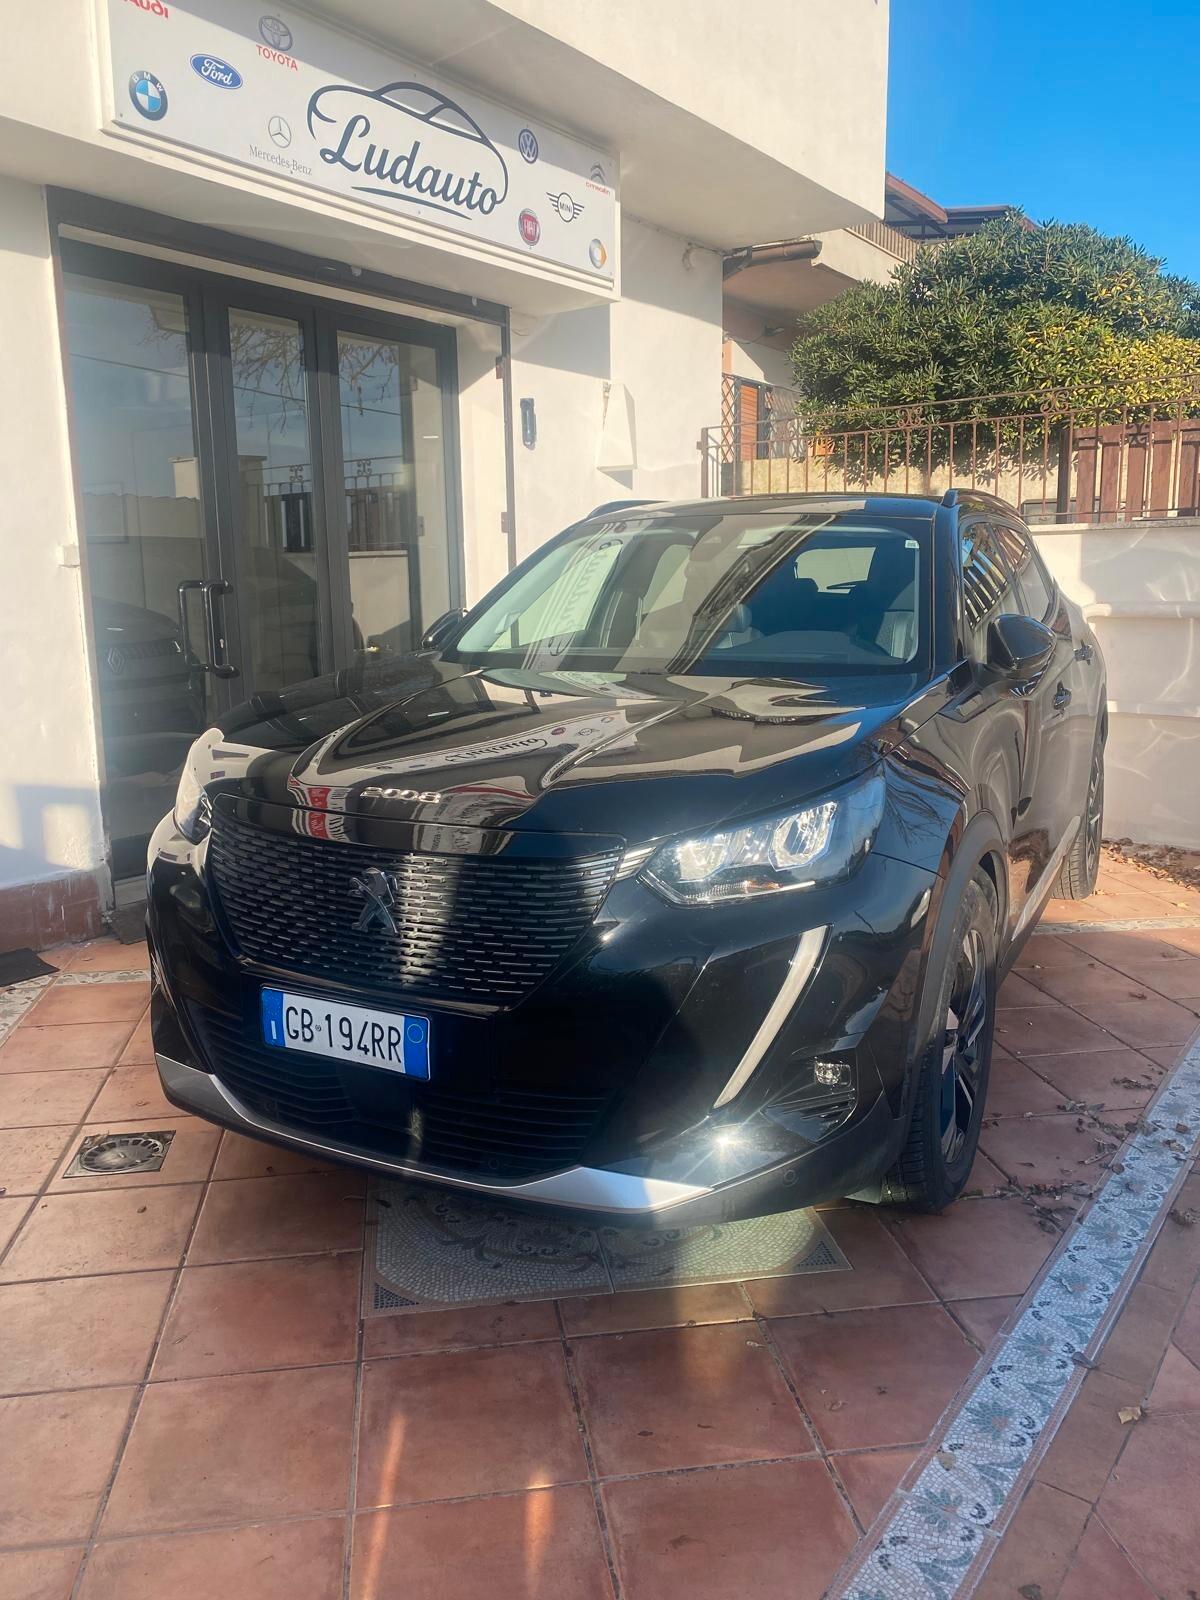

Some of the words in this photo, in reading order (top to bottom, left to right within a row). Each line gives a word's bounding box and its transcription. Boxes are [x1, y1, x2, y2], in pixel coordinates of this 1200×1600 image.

[256, 44, 298, 71] TOYOTA
[131, 71, 164, 92] BMW
[201, 58, 233, 86] Ford
[249, 144, 312, 176] Mercedes-Benz
[320, 115, 498, 215] Ludauto
[559, 201, 573, 213] MINI
[360, 786, 441, 804] 2008
